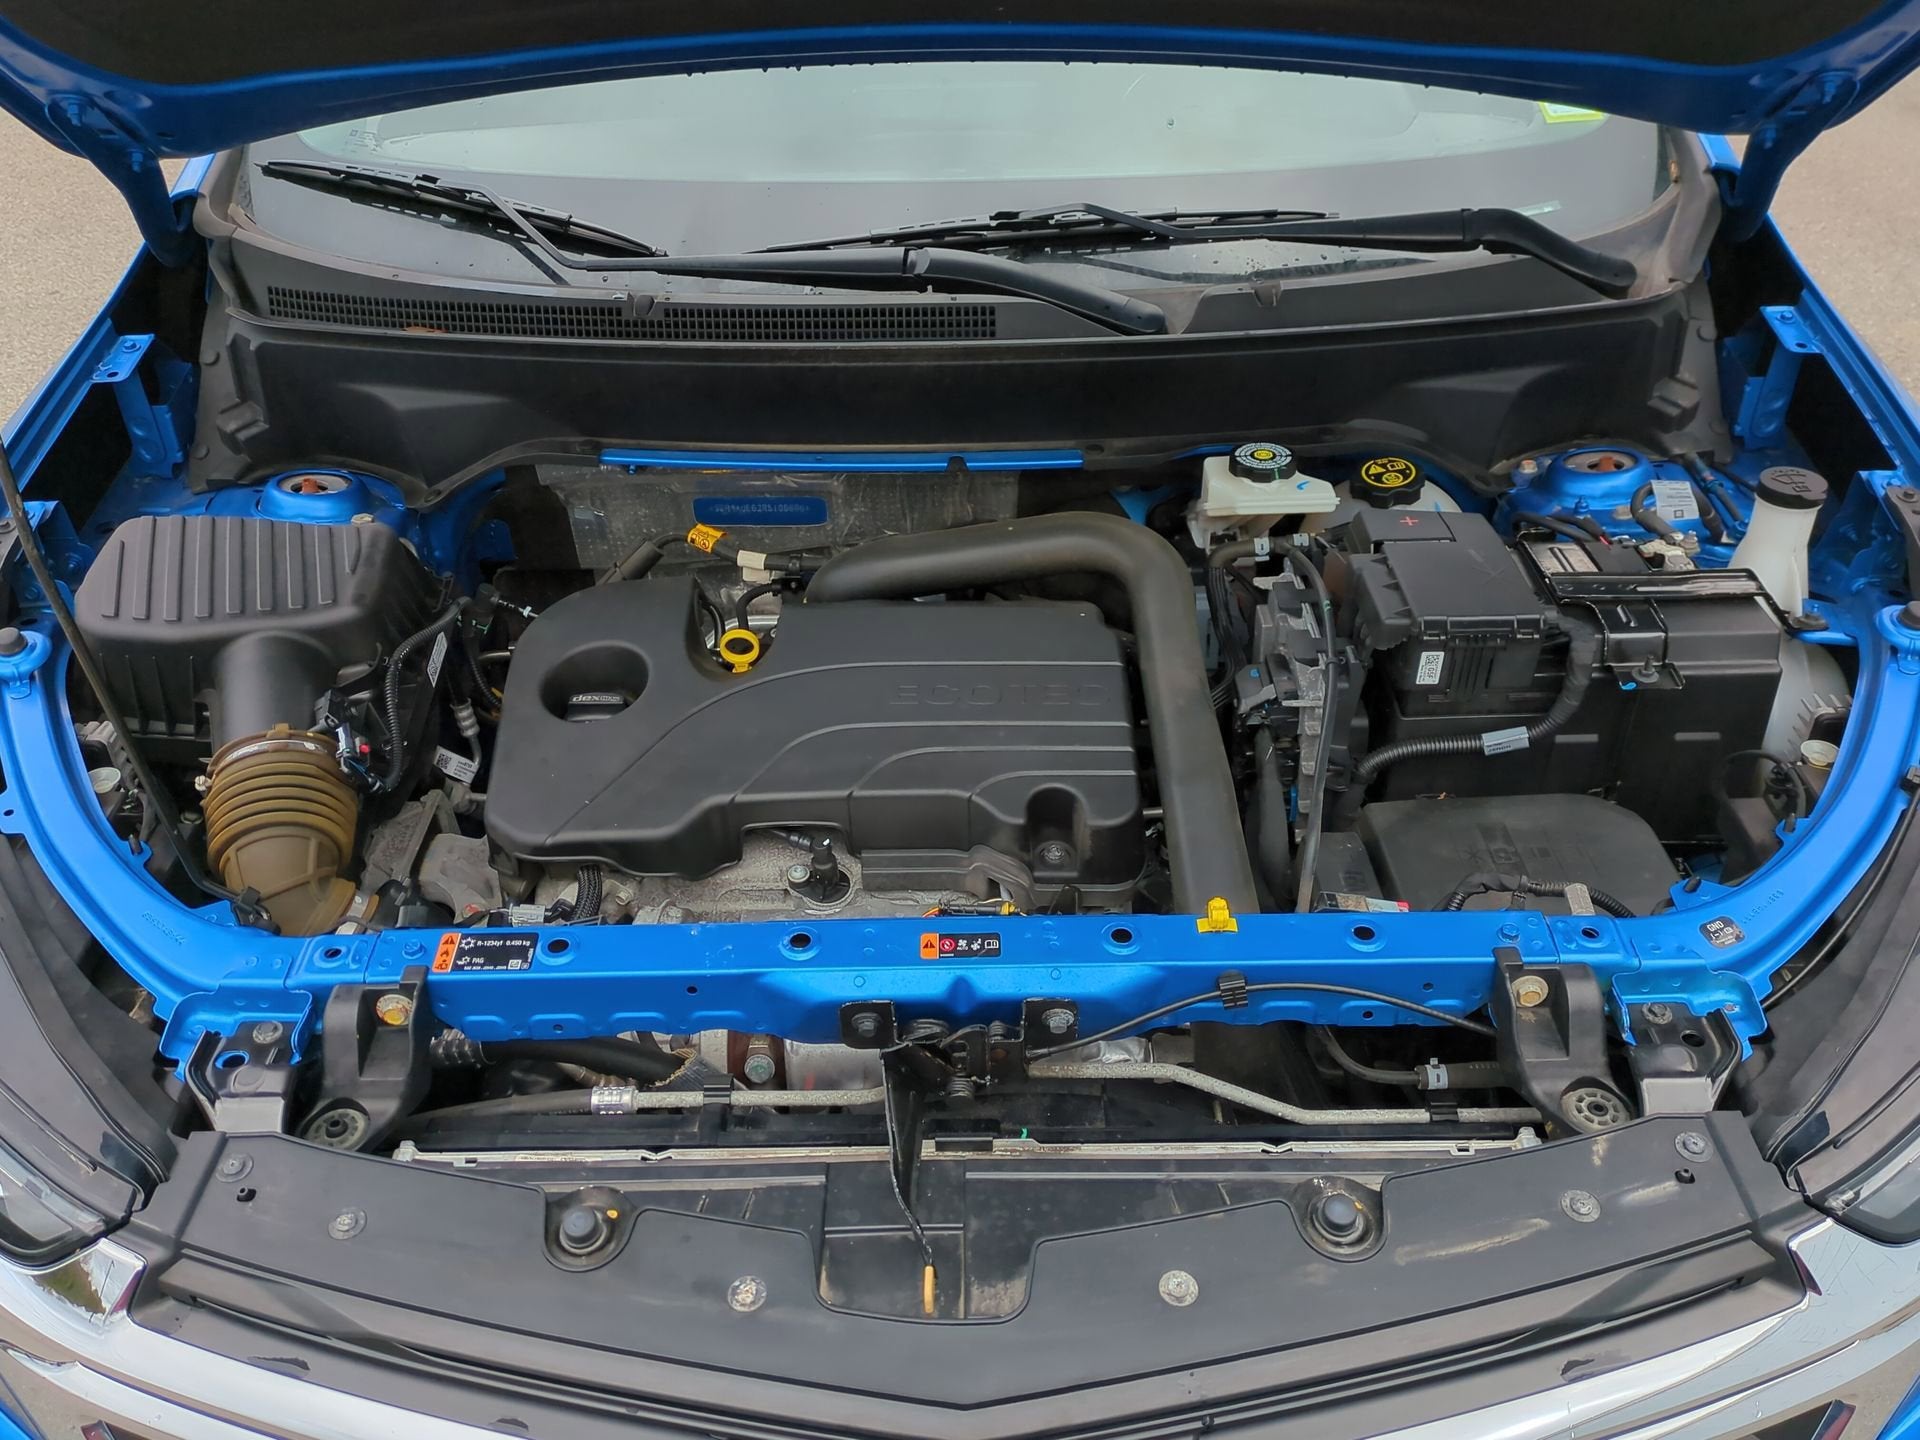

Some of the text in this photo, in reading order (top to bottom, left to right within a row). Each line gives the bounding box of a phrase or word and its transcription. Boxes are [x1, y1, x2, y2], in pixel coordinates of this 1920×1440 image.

[888, 684, 1112, 706] ECOTEC
[1706, 920, 1725, 932] GND
[476, 939, 503, 947] R-1234yf
[522, 939, 531, 947] kg
